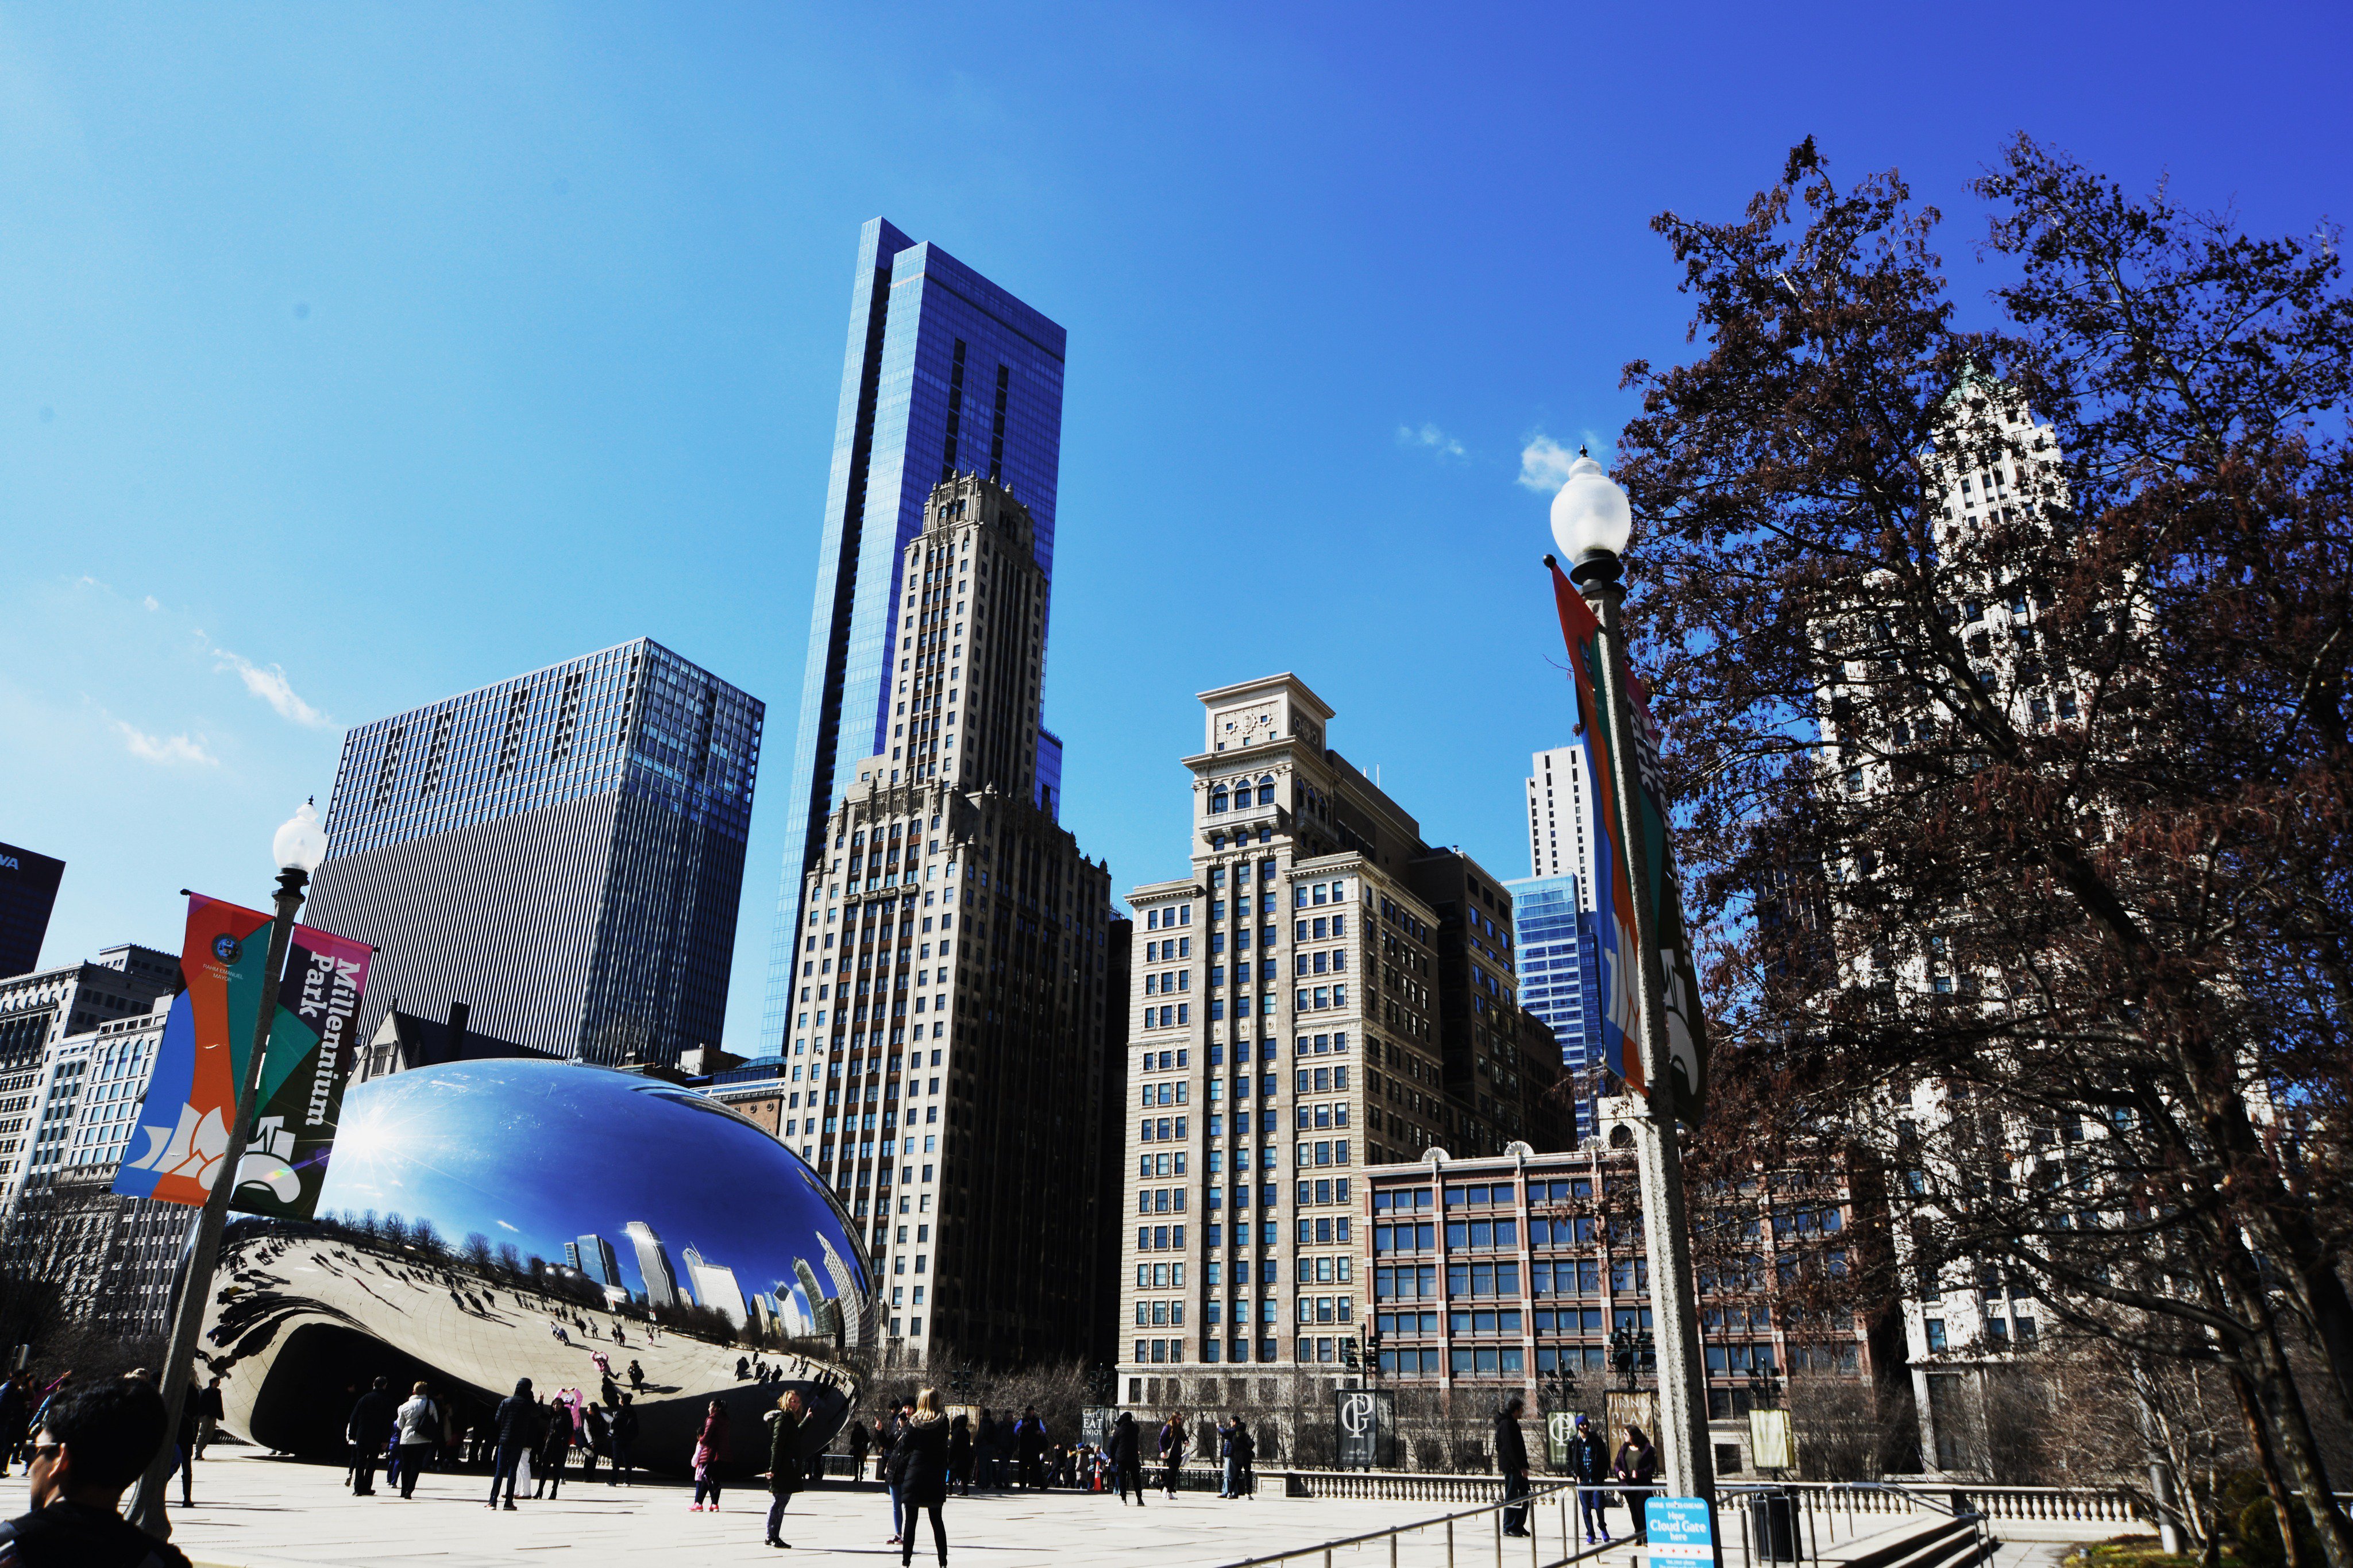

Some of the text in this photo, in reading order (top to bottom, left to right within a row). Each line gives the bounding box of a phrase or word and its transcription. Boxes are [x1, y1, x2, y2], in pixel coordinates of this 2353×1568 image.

[203, 963, 244, 980] RAHM EMANUEL
[213, 973, 232, 983] MAYOR
[299, 951, 335, 1018] Park
[305, 958, 361, 1126] Millennium
[1608, 1395, 1649, 1408] DRINK
[1083, 1418, 1102, 1429] EAT
[1611, 1411, 1648, 1425] PLAY
[1650, 1519, 1707, 1533] Cloud Gate
[1670, 1532, 1688, 1542] here
